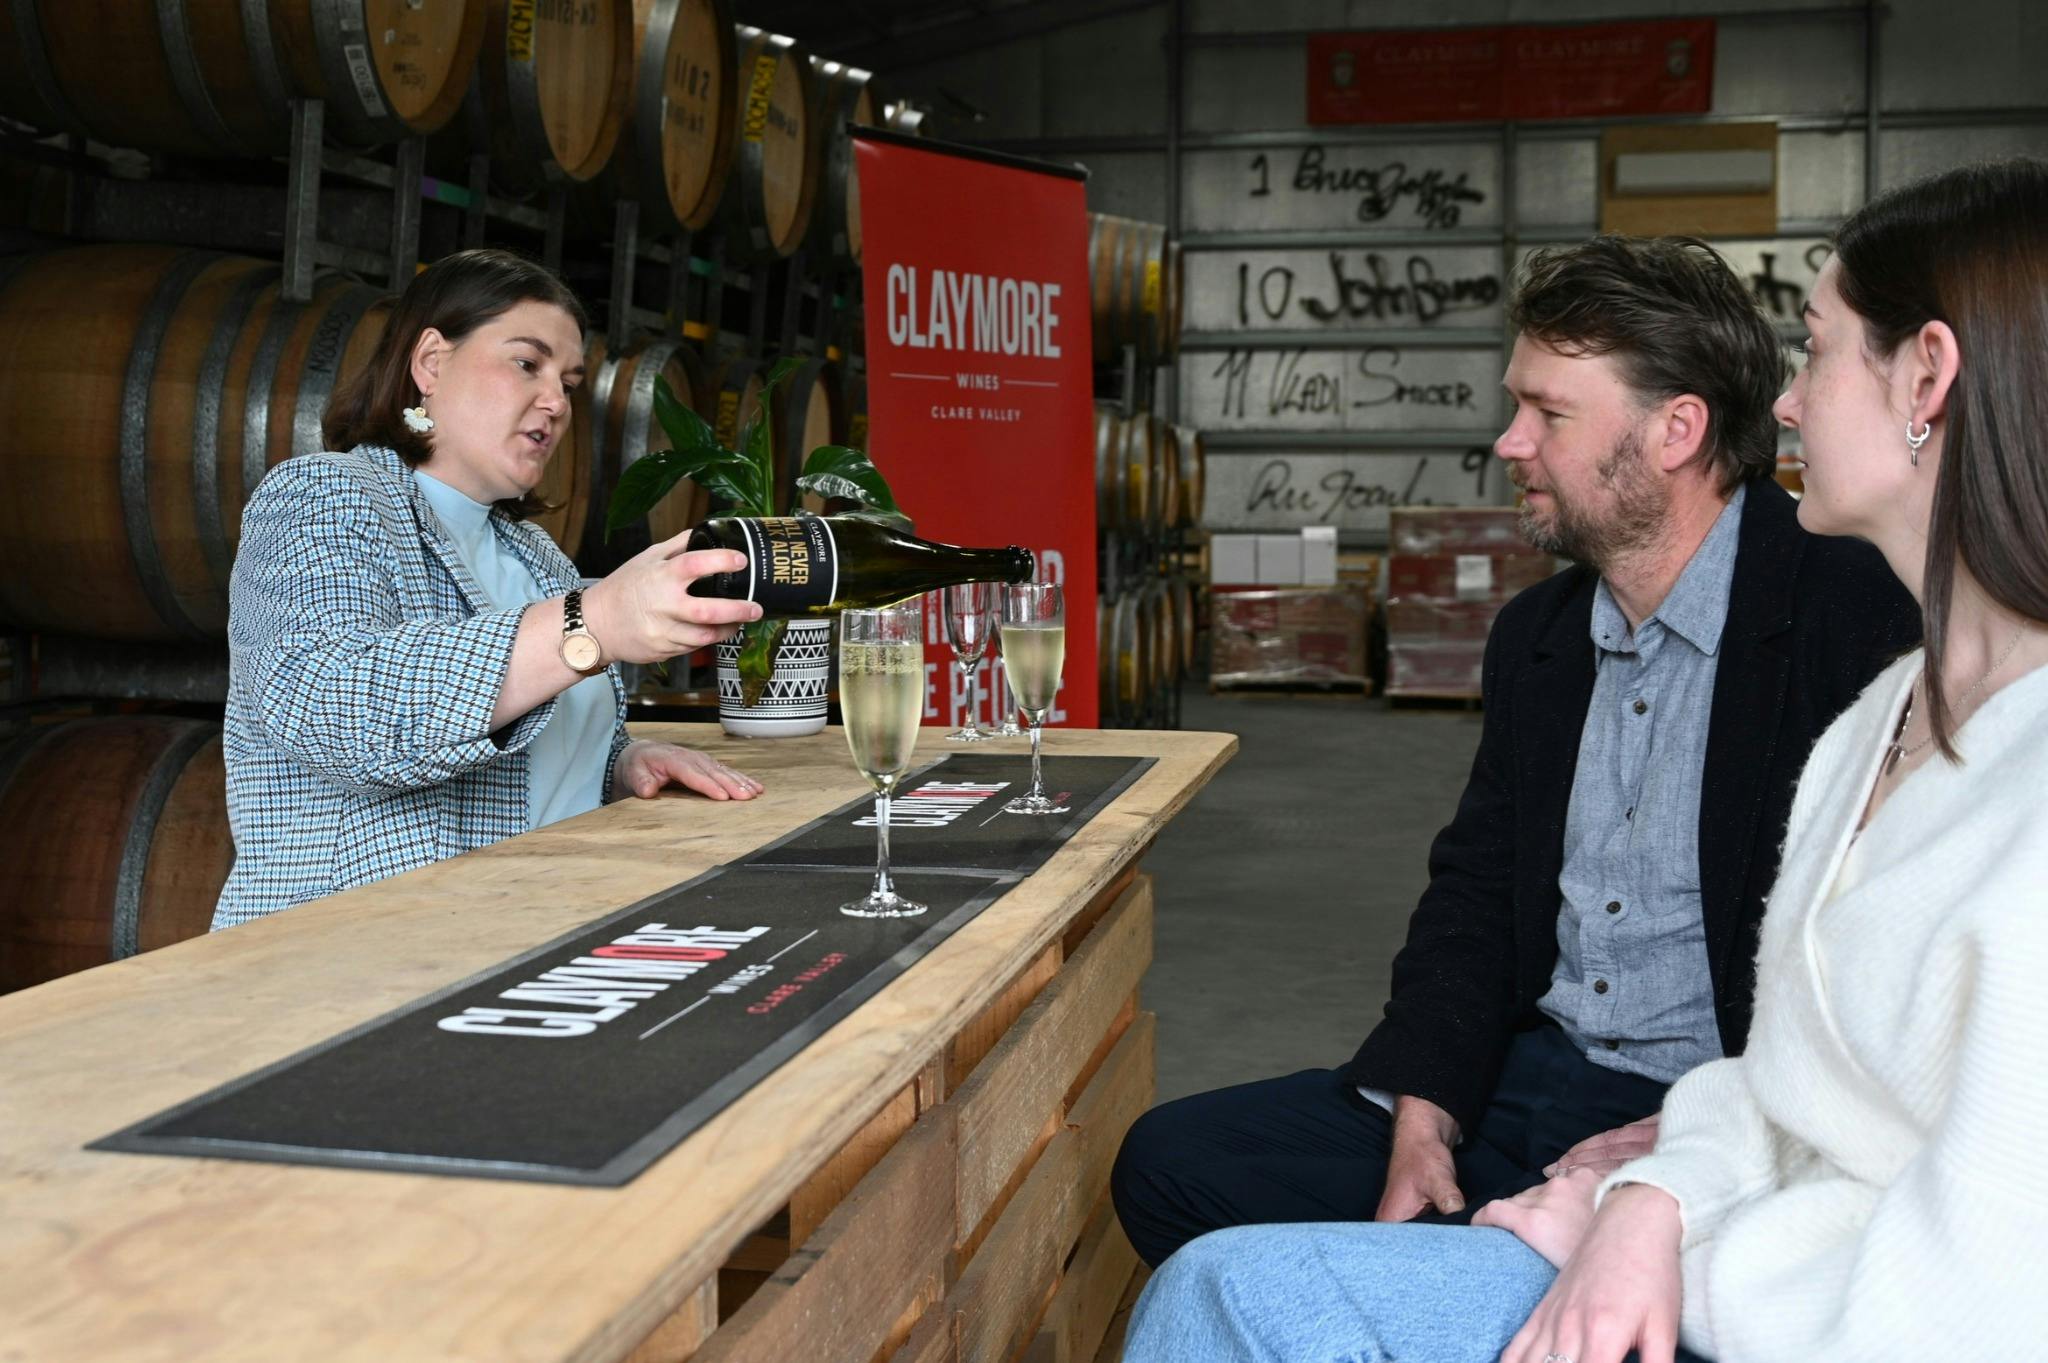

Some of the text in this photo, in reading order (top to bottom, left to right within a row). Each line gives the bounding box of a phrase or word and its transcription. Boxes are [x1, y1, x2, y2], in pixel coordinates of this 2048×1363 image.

[1250, 153, 1271, 197] 1
[887, 262, 1062, 359] CLAYMORE
[1238, 262, 1295, 326] 10
[956, 372, 1000, 391] WINES
[931, 405, 1021, 423] CLARE VALLEY
[1461, 447, 1493, 498] 9
[771, 540, 791, 585] ALONE
[789, 541, 809, 585] NEVER
[810, 522, 827, 563] CLAYMORE
[851, 781, 1012, 827] CLAYMORE
[437, 922, 772, 1038] CLAYMORE
[708, 964, 774, 994] WINES
[747, 952, 848, 1014] CLARE VALLEY
